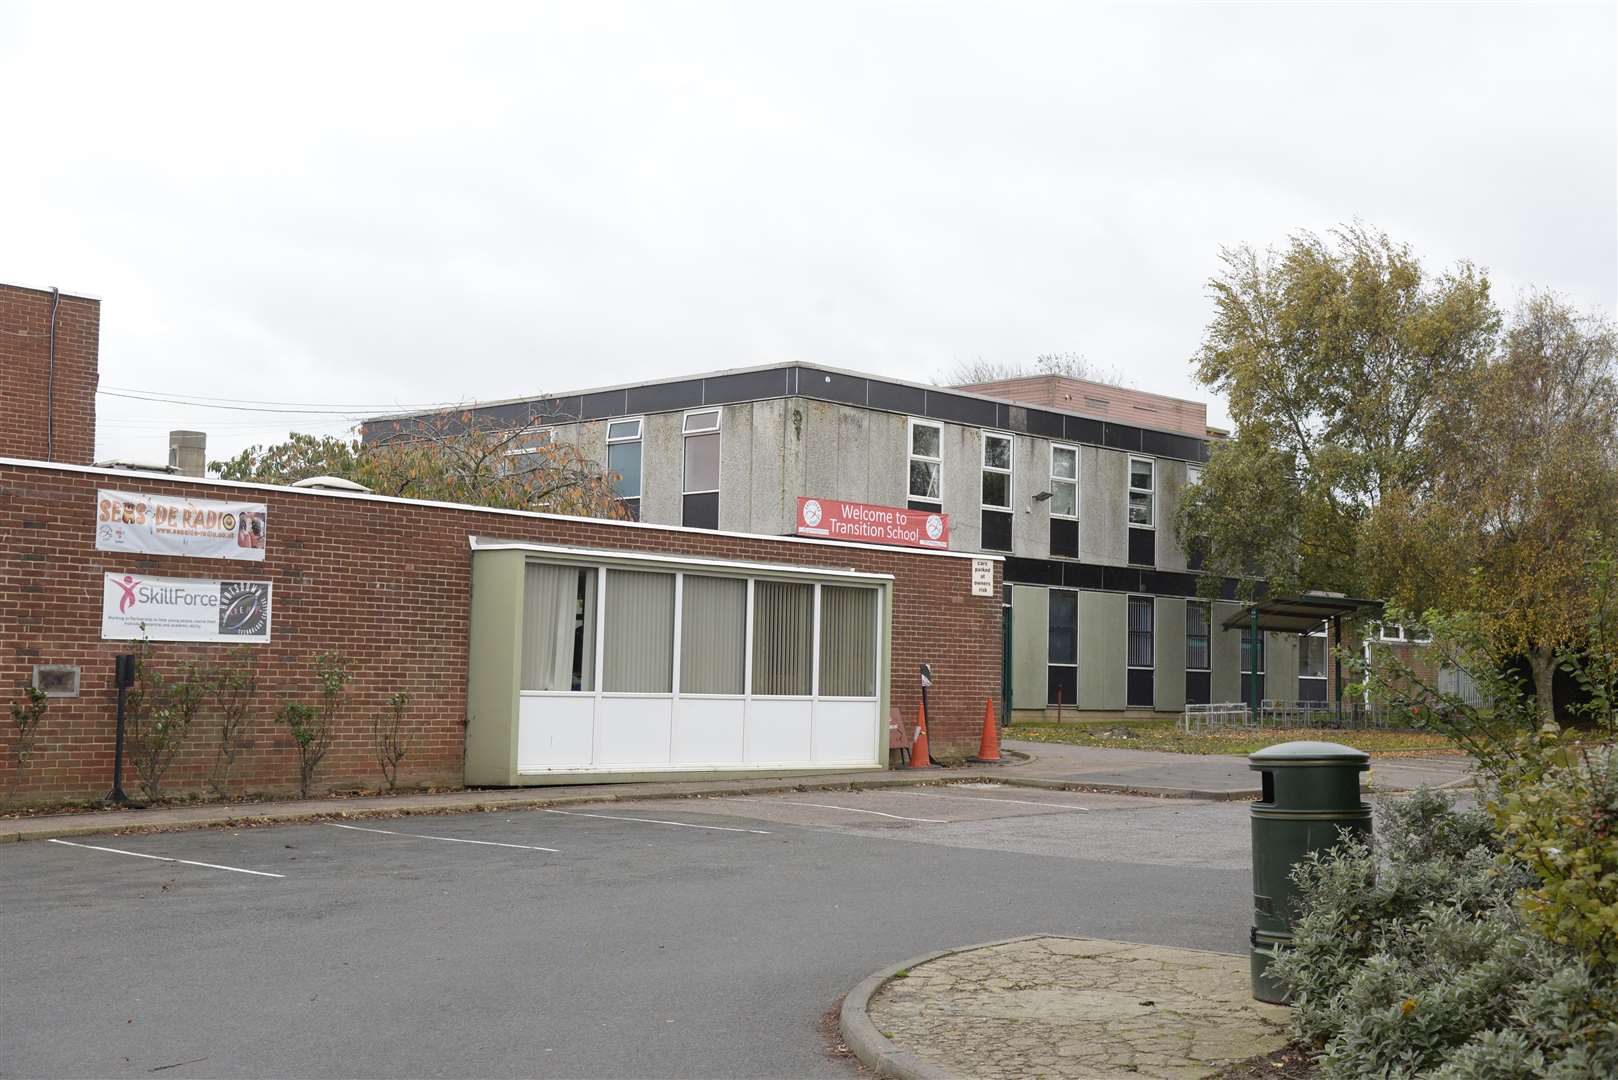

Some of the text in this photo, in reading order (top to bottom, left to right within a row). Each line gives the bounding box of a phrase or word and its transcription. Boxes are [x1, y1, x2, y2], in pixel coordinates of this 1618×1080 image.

[182, 505, 236, 531] RADIO
[841, 504, 893, 524] Welcome
[896, 512, 907, 525] to
[830, 518, 919, 542] Transition School
[138, 586, 218, 607] SkillForce
